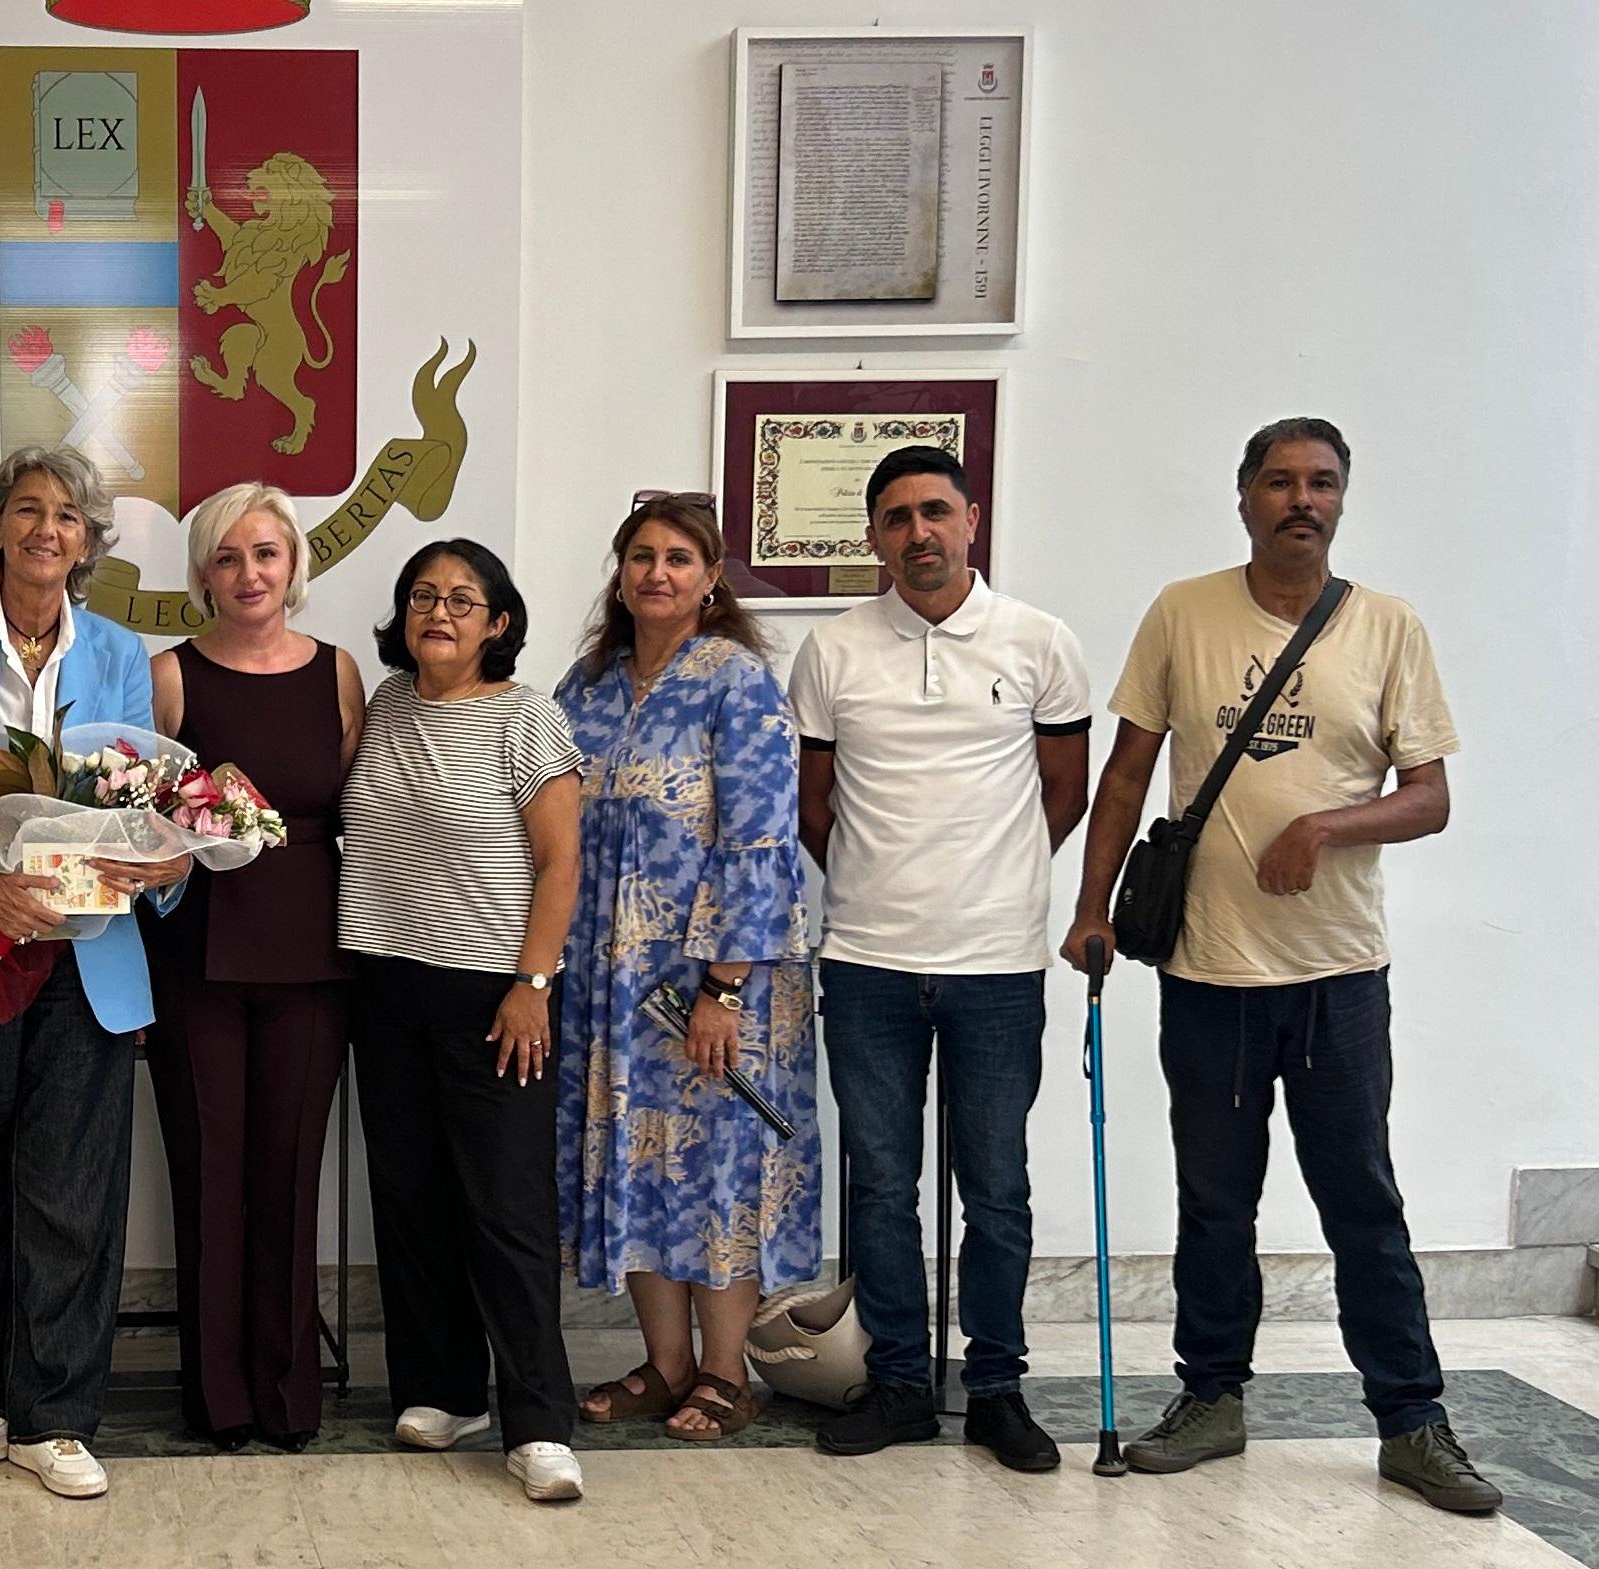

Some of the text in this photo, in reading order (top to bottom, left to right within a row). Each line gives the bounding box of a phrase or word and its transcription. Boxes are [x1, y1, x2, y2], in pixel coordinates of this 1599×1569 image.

[53, 117, 126, 150] LEX
[978, 116, 993, 162] LEGGI
[126, 447, 414, 629] LEG BERTAS
[1216, 706, 1242, 729] GO
[1266, 713, 1316, 739] GREEN
